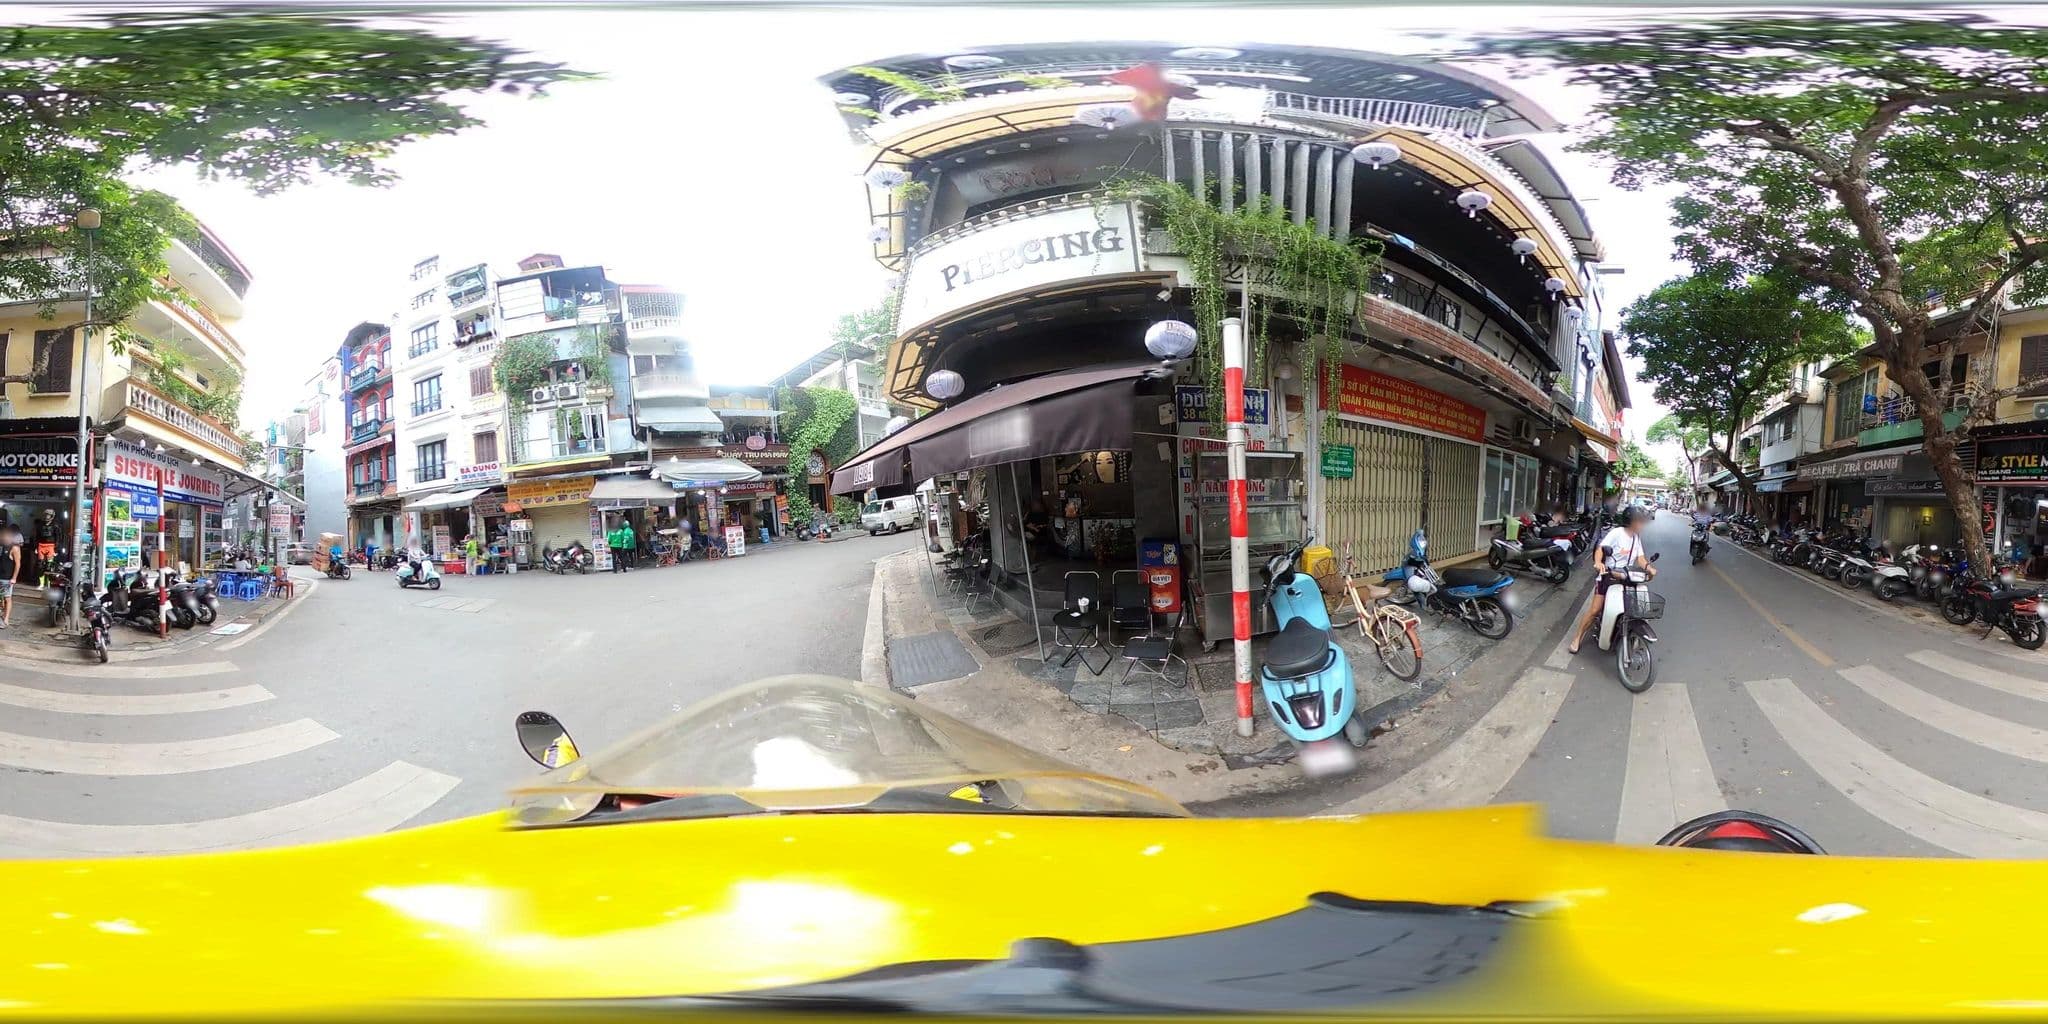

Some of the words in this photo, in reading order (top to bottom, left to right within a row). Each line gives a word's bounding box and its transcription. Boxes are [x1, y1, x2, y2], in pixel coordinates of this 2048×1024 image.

[941, 226, 1125, 291] PIERCING
[1183, 409, 1196, 419] 38
[1864, 457, 1898, 472] CHANH
[2001, 455, 2039, 468] STYLE
[179, 473, 221, 497] JOURNEYS
